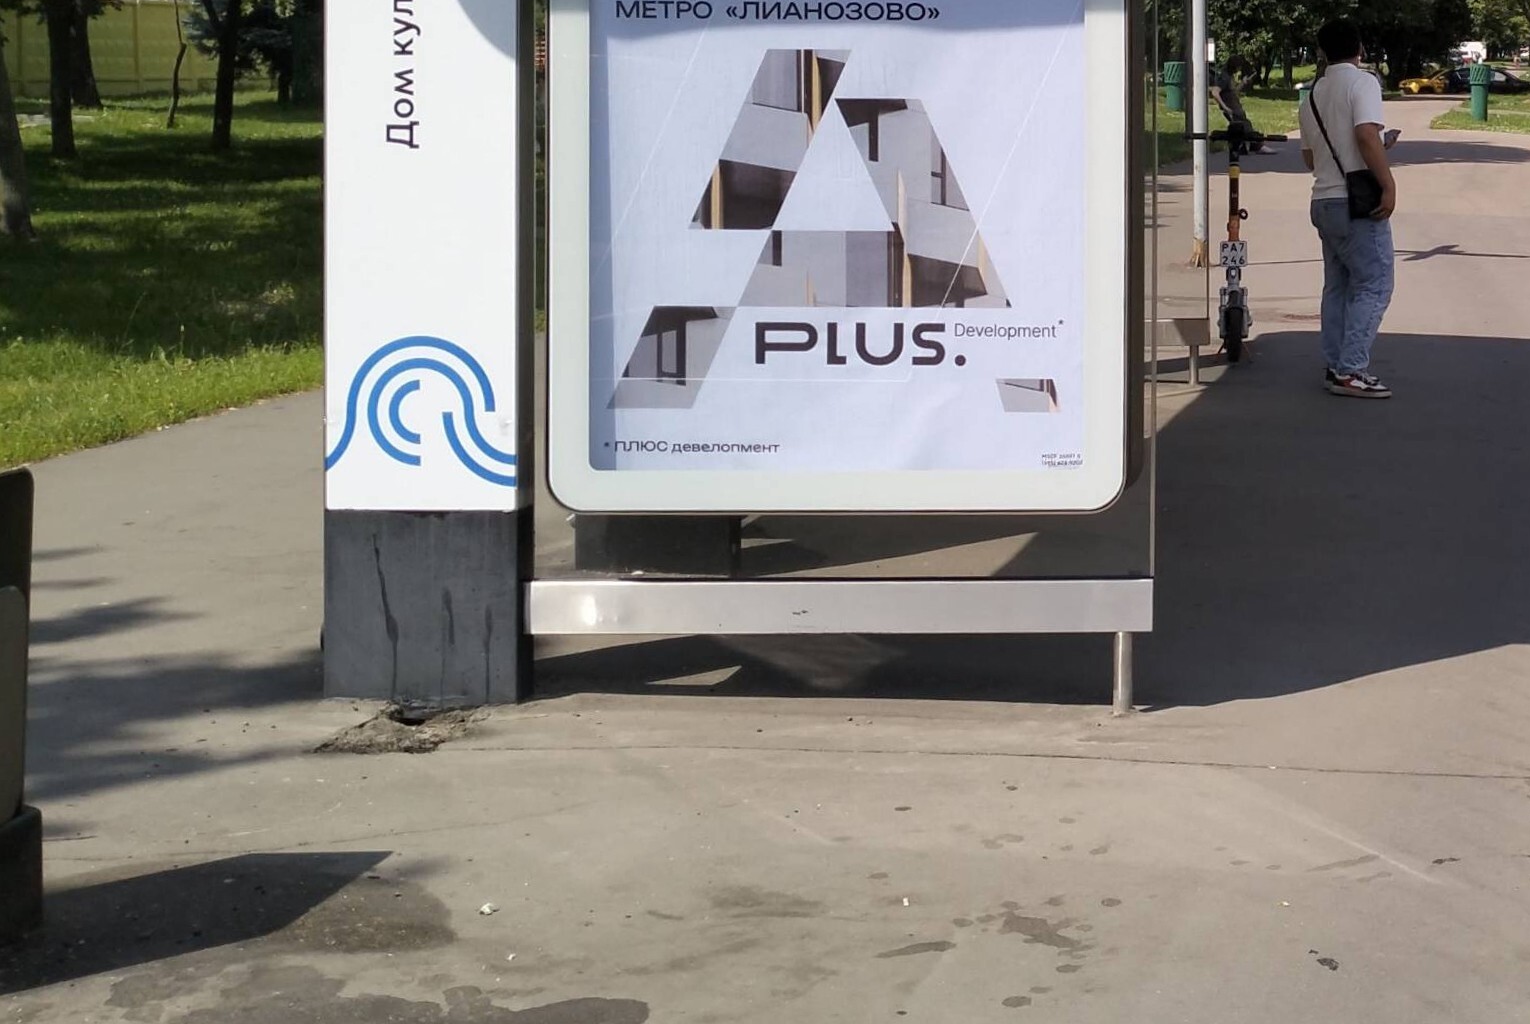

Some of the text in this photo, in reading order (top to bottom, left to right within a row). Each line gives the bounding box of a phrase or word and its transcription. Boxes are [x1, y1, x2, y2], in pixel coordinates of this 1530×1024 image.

[615, 0, 941, 22] МЕТРО «ЛИАНОЗОВО»
[386, 68, 420, 149] Дом
[1221, 256, 1246, 266] 246
[754, 321, 967, 367] PLUS.
[614, 440, 781, 454] ПЛЮС девелопмент
